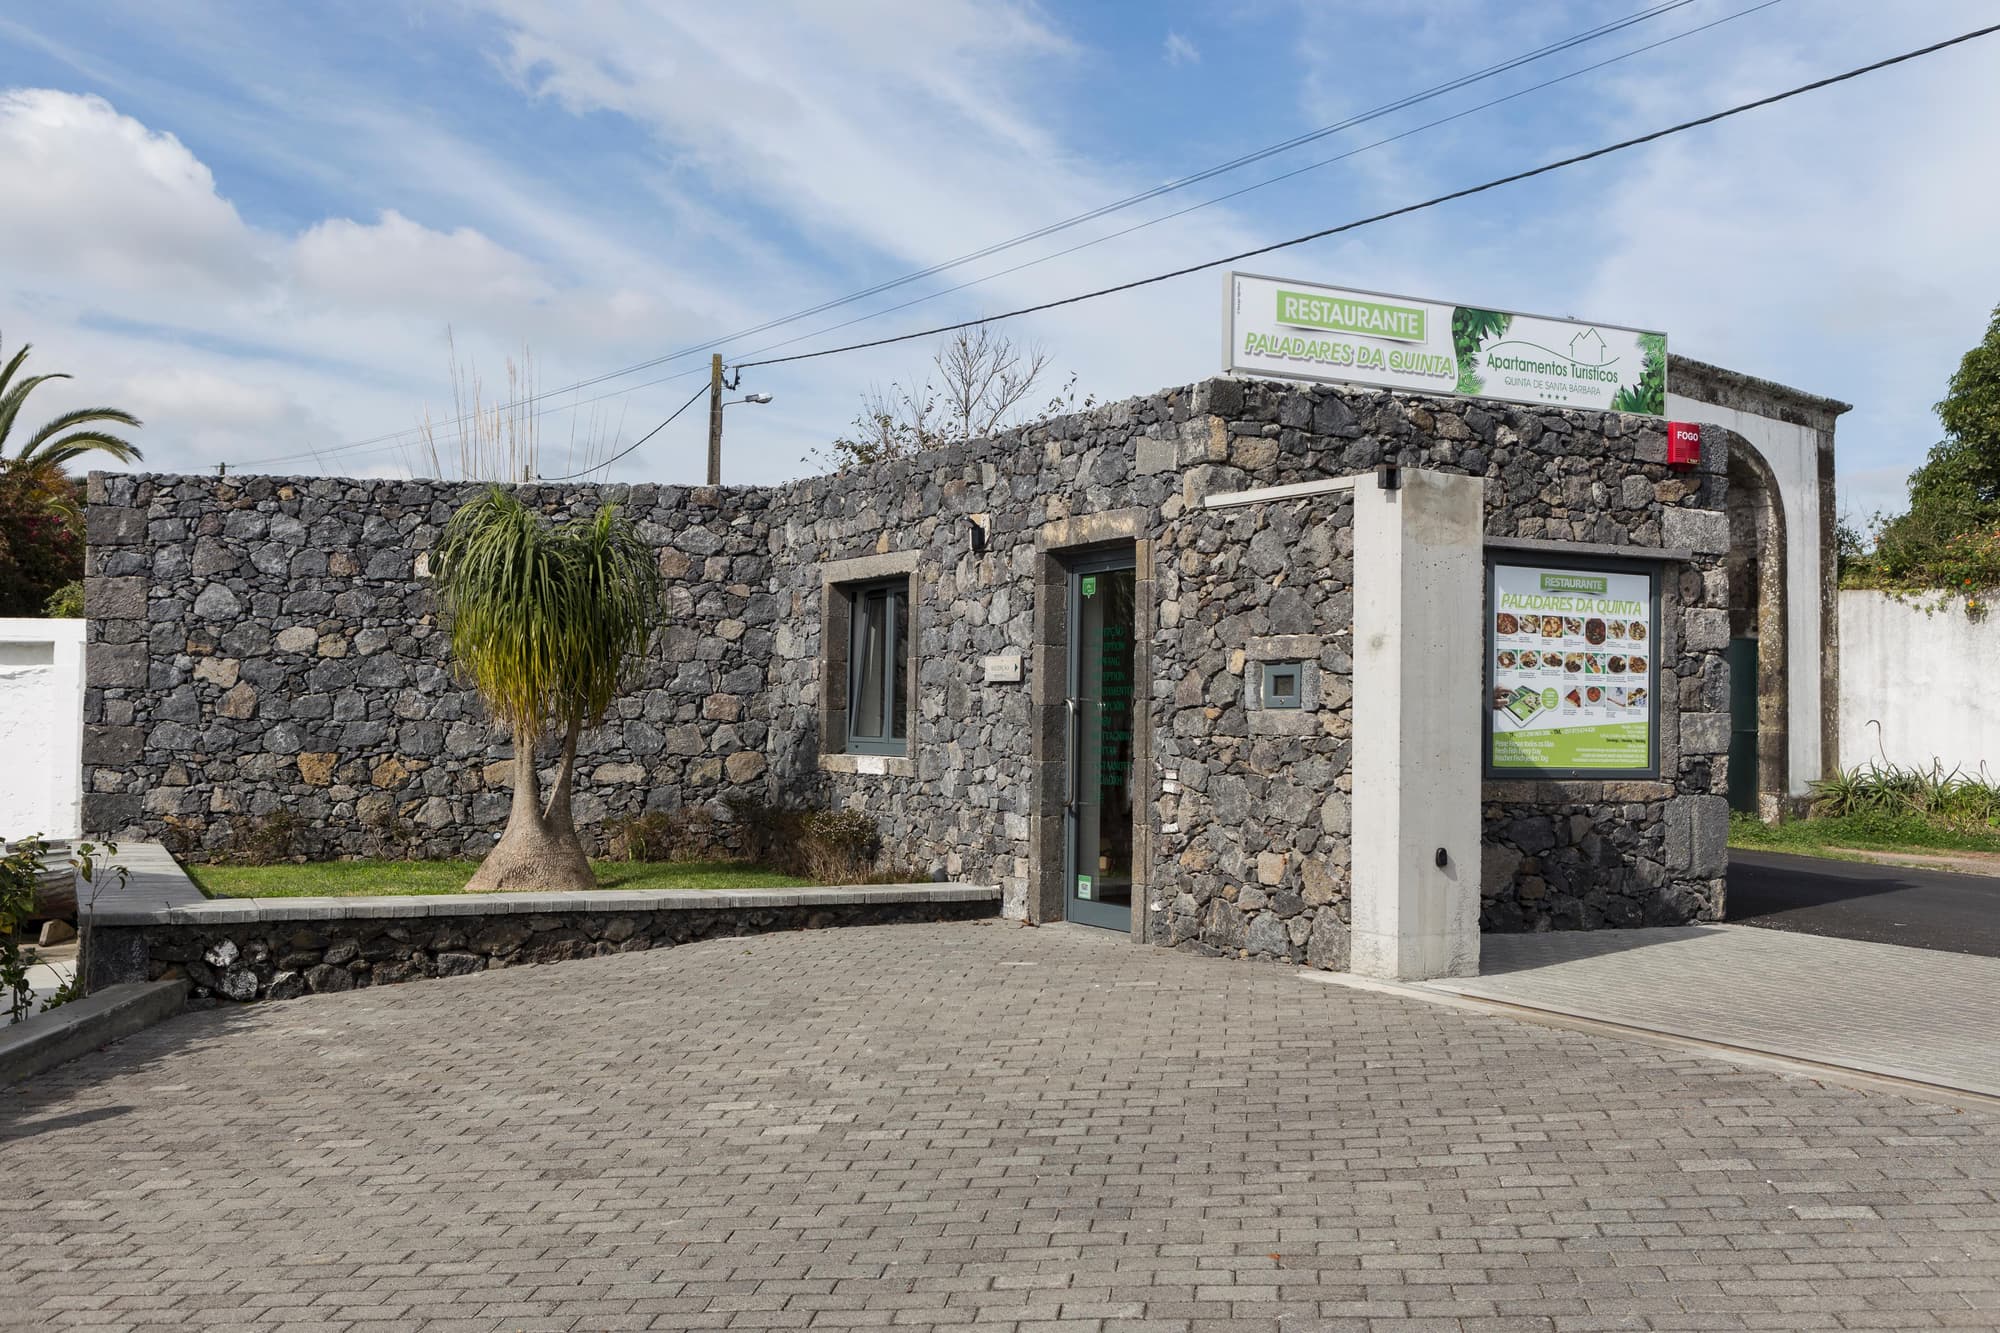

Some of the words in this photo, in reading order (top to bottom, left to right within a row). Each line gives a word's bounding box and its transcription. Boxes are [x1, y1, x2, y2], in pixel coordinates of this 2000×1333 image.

[1285, 296, 1419, 334] RESTAURANTE
[1245, 332, 1352, 364] PALADARES
[1356, 346, 1384, 367] DA
[1389, 350, 1454, 375] QUINTA
[1487, 353, 1567, 377] Apartamentos
[1504, 376, 1531, 387] QUINTA
[1533, 379, 1543, 389] DE
[1545, 380, 1567, 391] SANTA
[1677, 431, 1698, 441] FOGO
[1545, 577, 1603, 589] RESTAURANTE
[1501, 593, 1573, 611] PALADARES
[1576, 598, 1593, 612] DA
[1597, 599, 1641, 615] QUINTA
